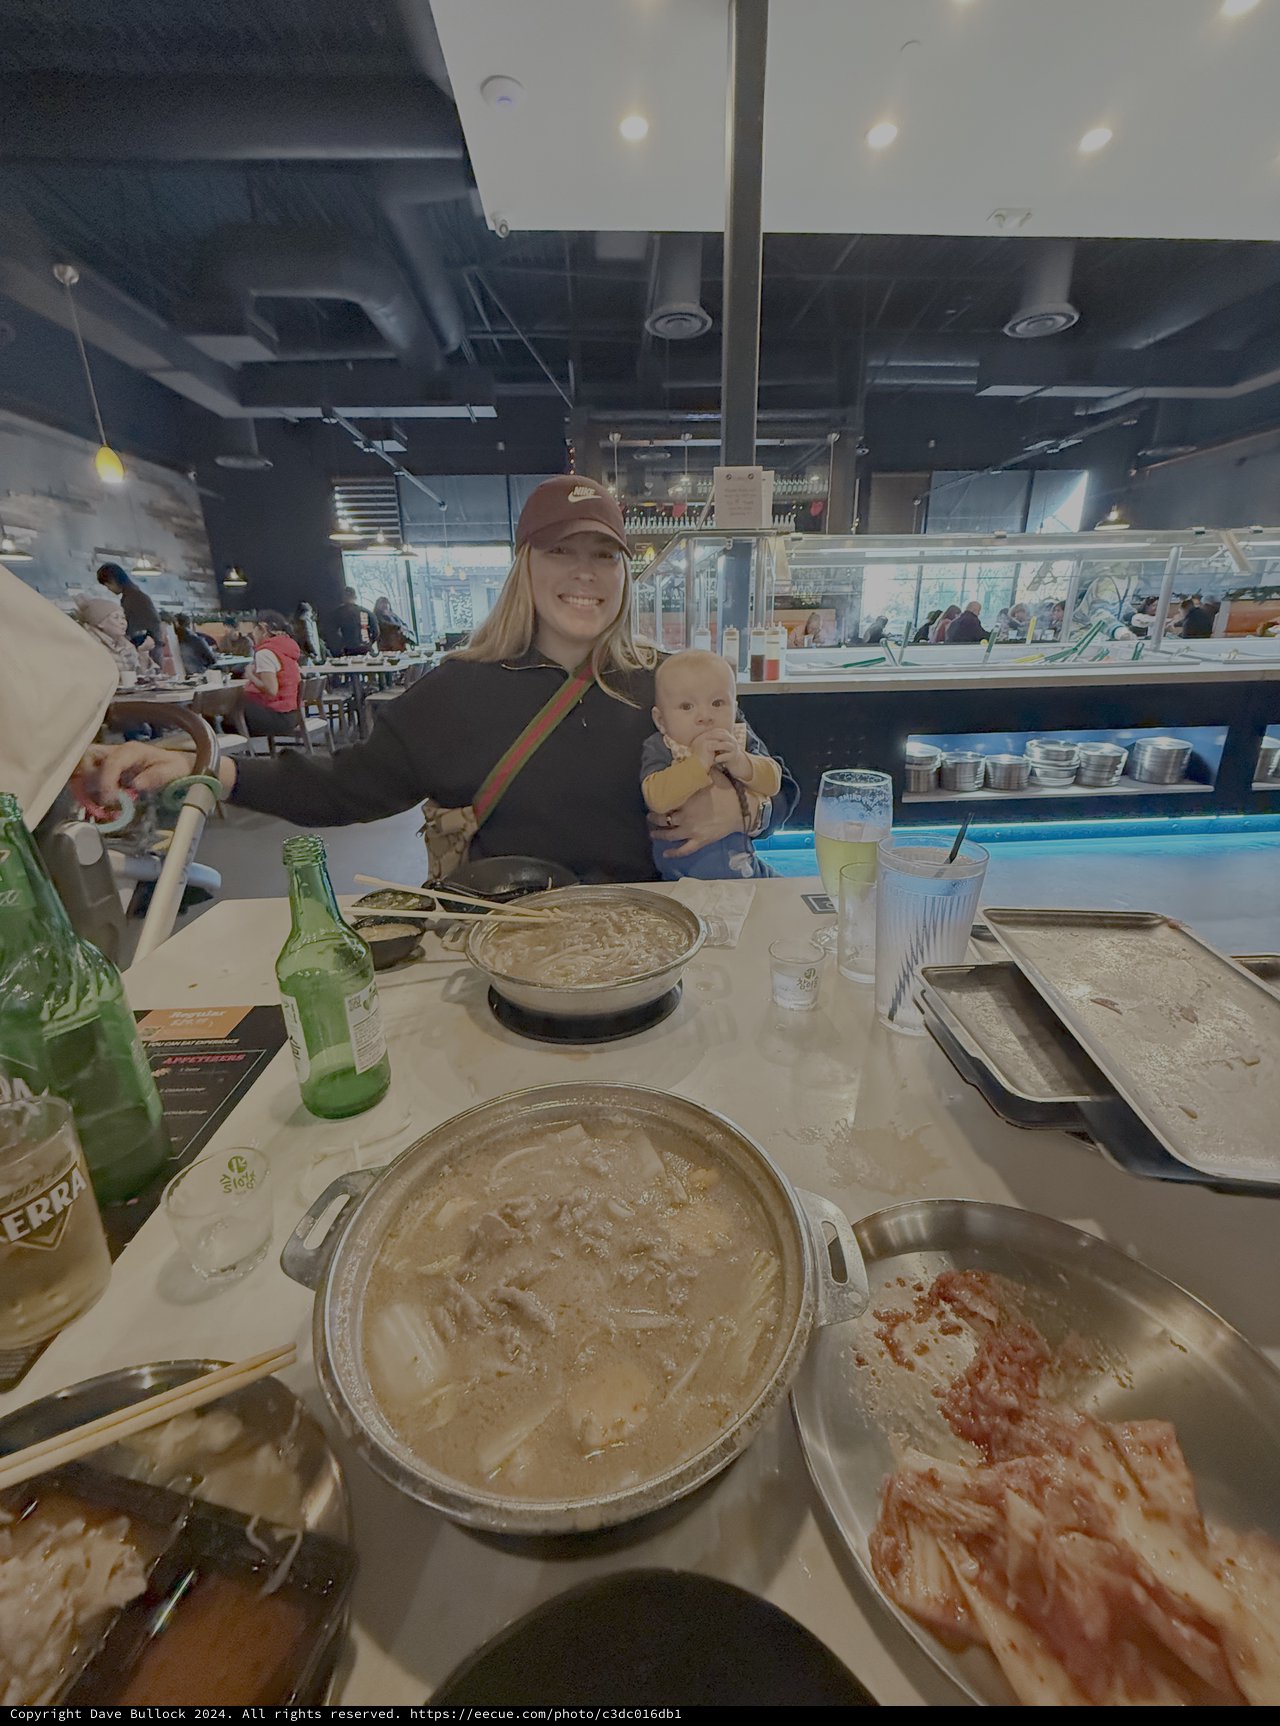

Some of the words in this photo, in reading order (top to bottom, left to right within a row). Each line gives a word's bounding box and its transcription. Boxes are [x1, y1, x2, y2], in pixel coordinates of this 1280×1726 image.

[573, 486, 596, 496] NIKE
[169, 1010, 226, 1019] Regular
[164, 1039, 180, 1047] CAN
[195, 1038, 240, 1046] EXPERIENCE
[163, 1054, 246, 1064] APPETIZERS
[1, 1167, 87, 1242] ERRA
